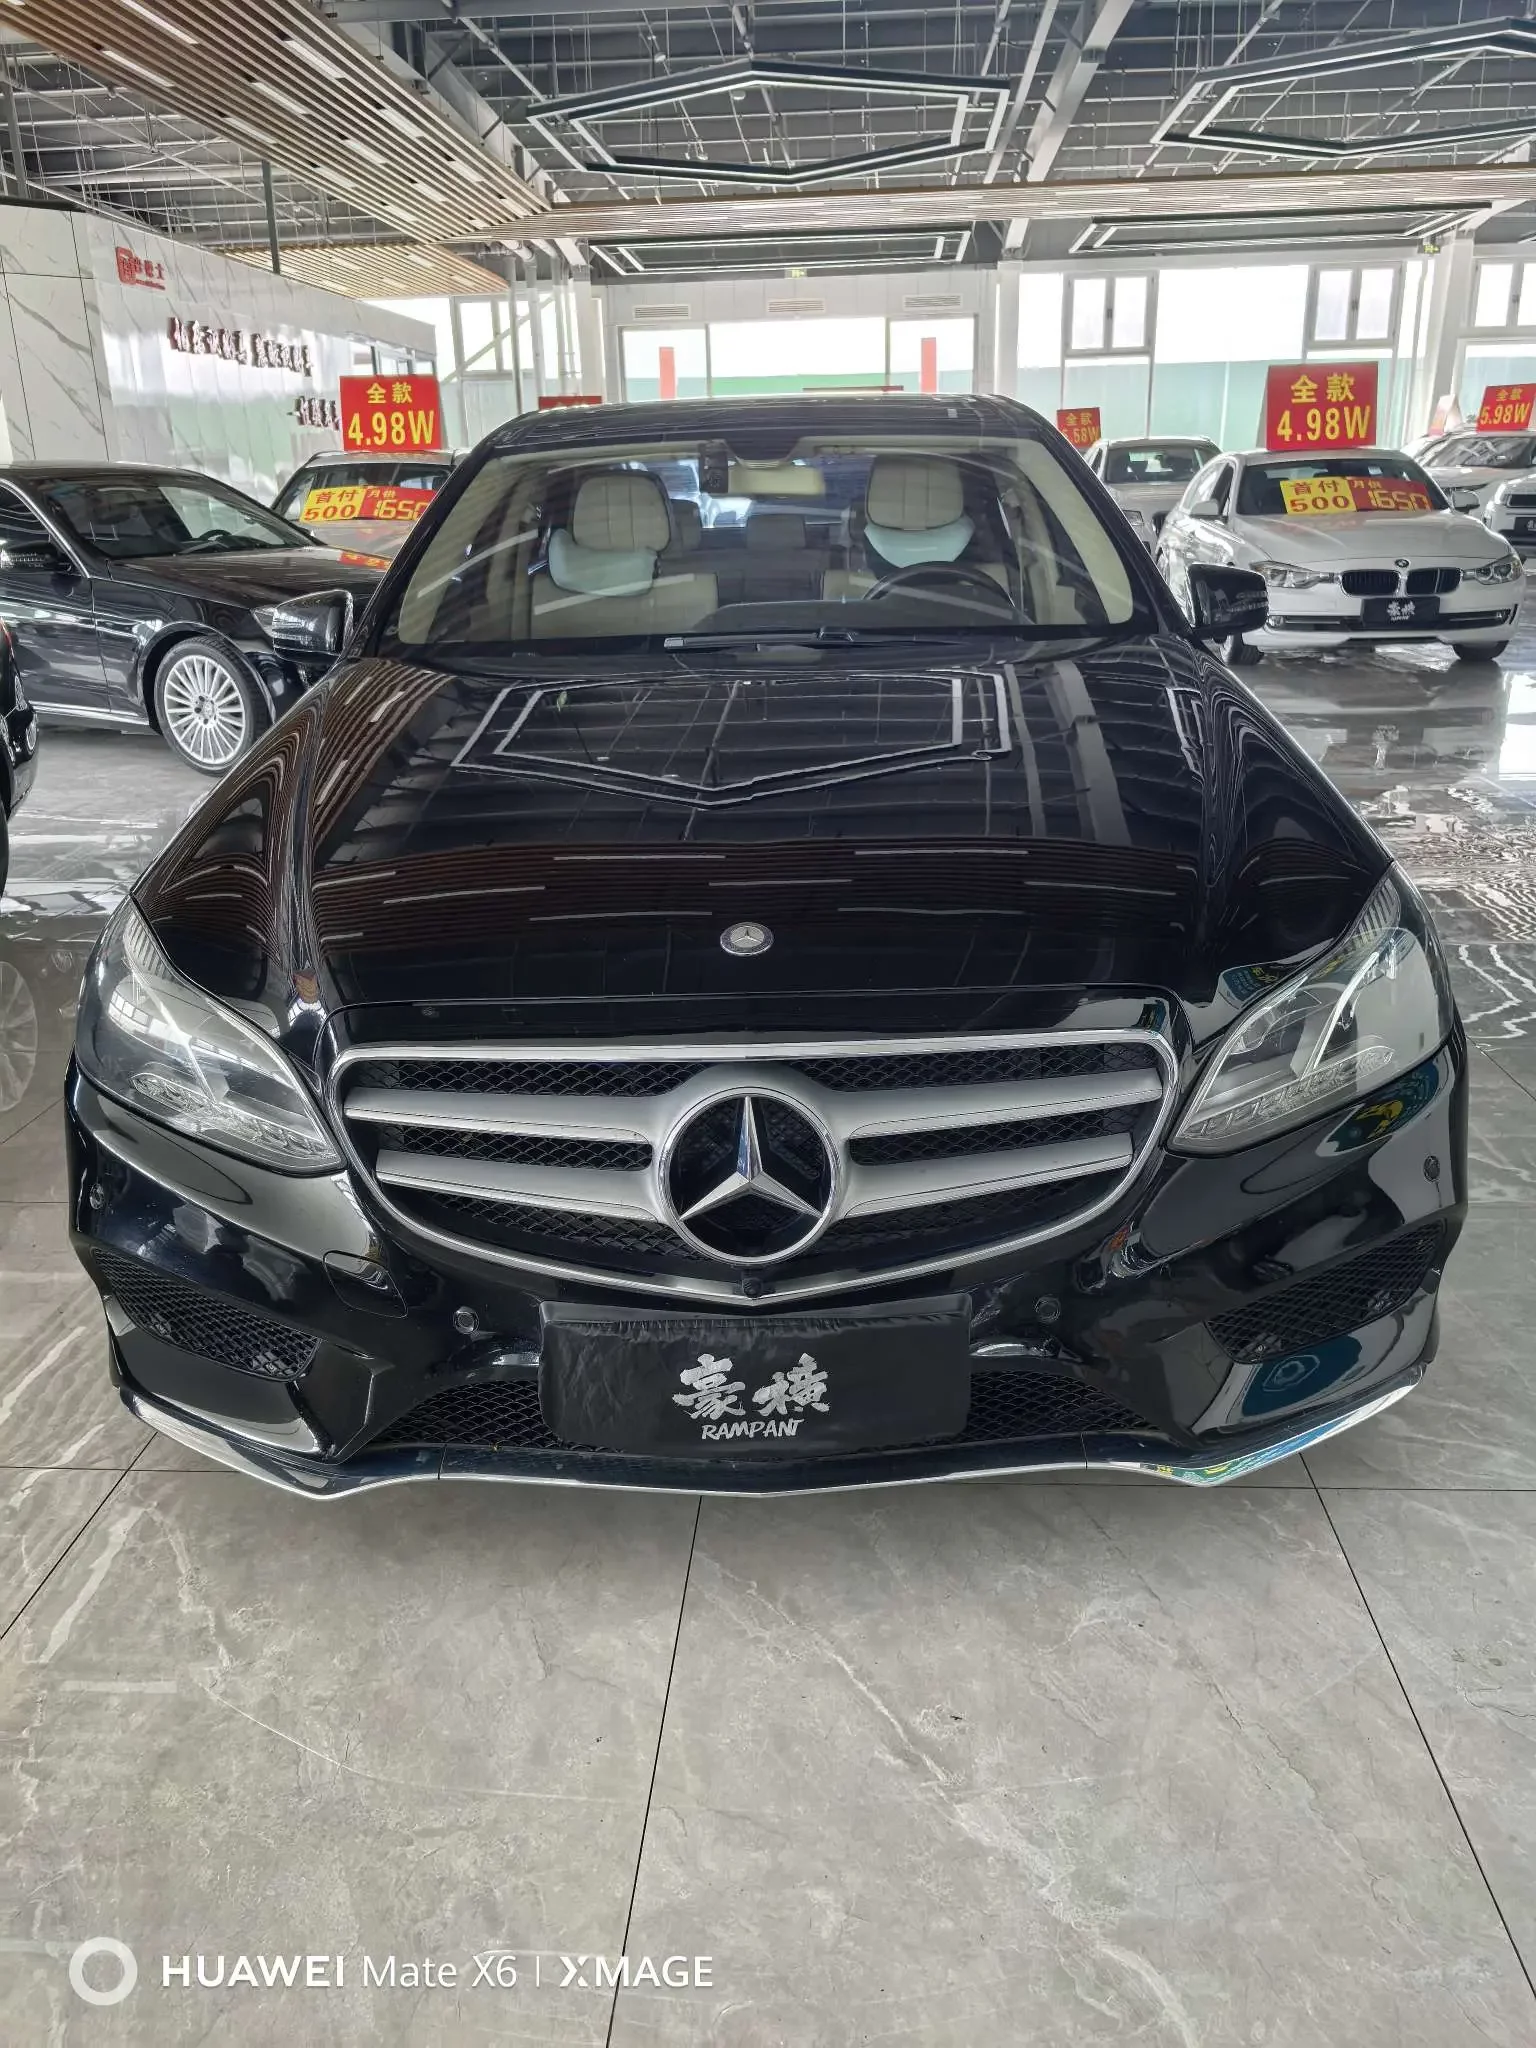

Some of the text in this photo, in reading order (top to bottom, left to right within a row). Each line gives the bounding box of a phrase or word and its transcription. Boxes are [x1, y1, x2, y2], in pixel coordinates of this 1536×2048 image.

[366, 381, 413, 405] 全款
[1290, 371, 1356, 404] 全款
[1276, 404, 1371, 442] 4.98W
[1479, 402, 1531, 425] 5.98W
[347, 409, 435, 446] 4.98W
[315, 489, 357, 505] 首付
[1290, 479, 1340, 496] 首付
[304, 504, 357, 521] 500
[1289, 495, 1350, 513] 500
[701, 1418, 805, 1441] RAMPANT
